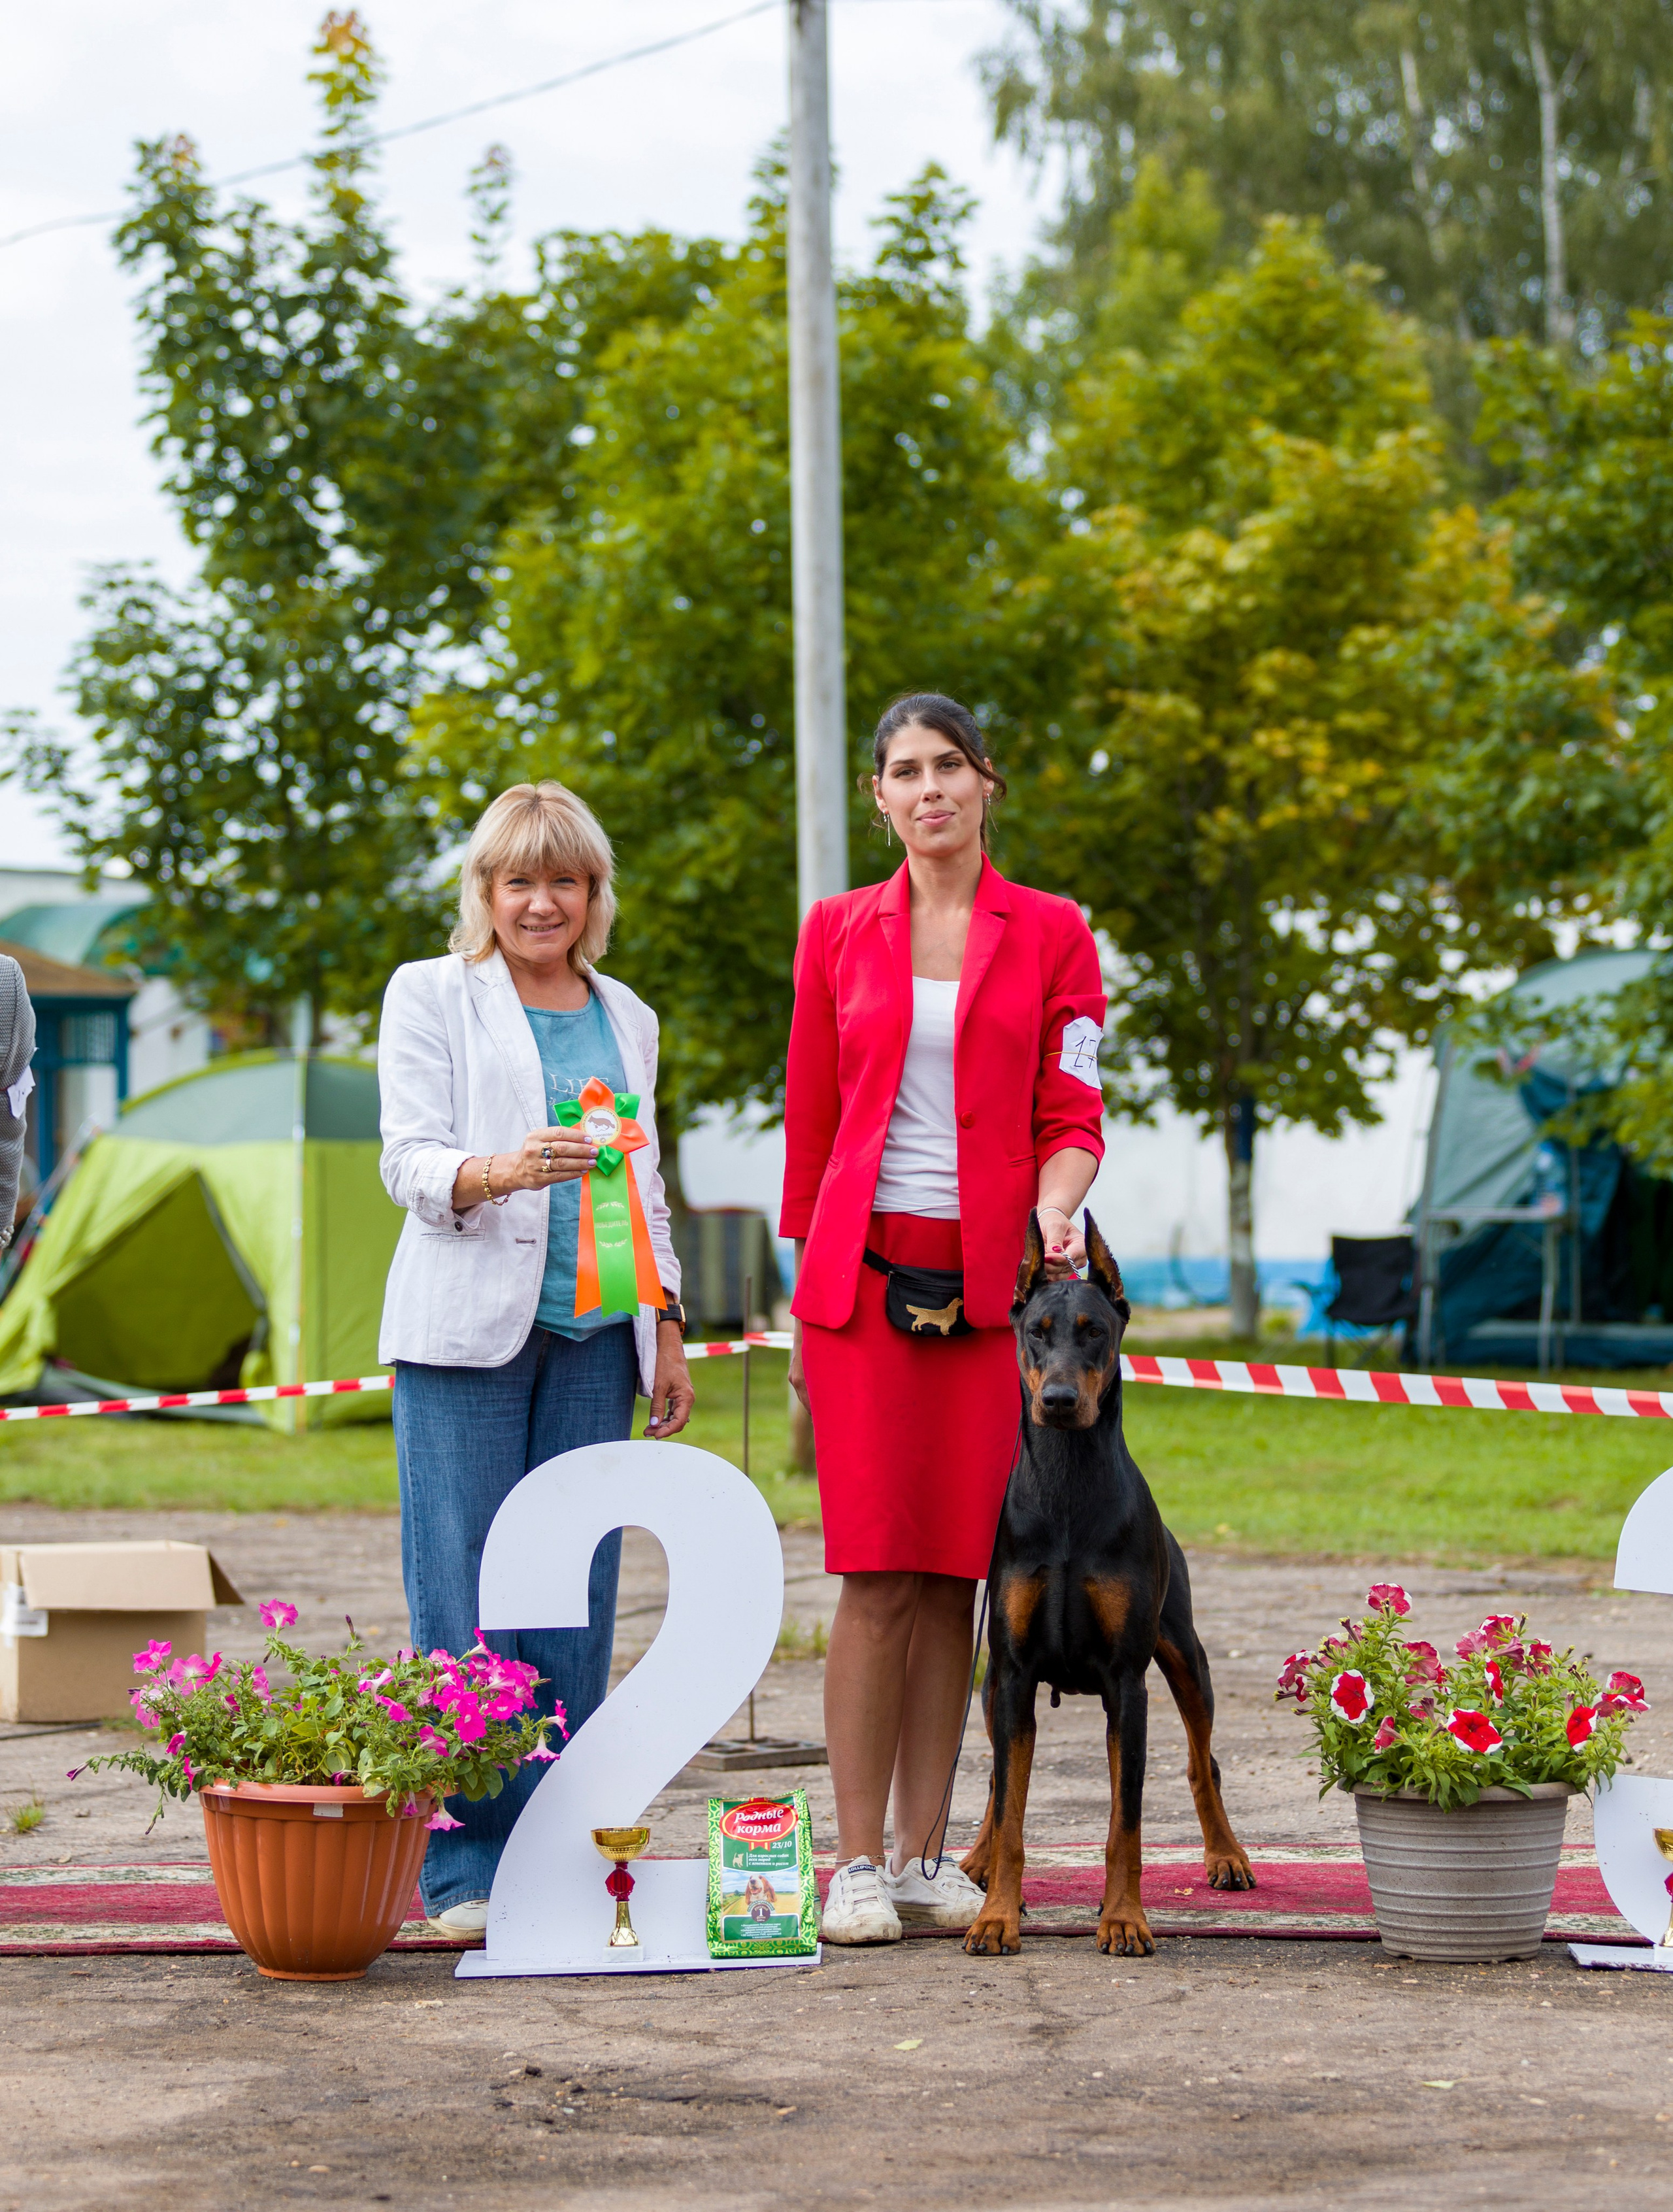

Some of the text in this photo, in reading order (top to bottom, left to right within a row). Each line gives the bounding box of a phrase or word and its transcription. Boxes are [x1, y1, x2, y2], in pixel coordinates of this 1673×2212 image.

[1075, 1036, 1096, 1069] 17
[549, 1072, 609, 1095] LIF
[595, 1220, 628, 1228] ПОБЕДИТЕЛЬ
[479, 1440, 784, 1960] 2
[734, 1809, 784, 1824] Родные
[737, 1823, 781, 1835] корма
[772, 1841, 792, 1849] 23/10
